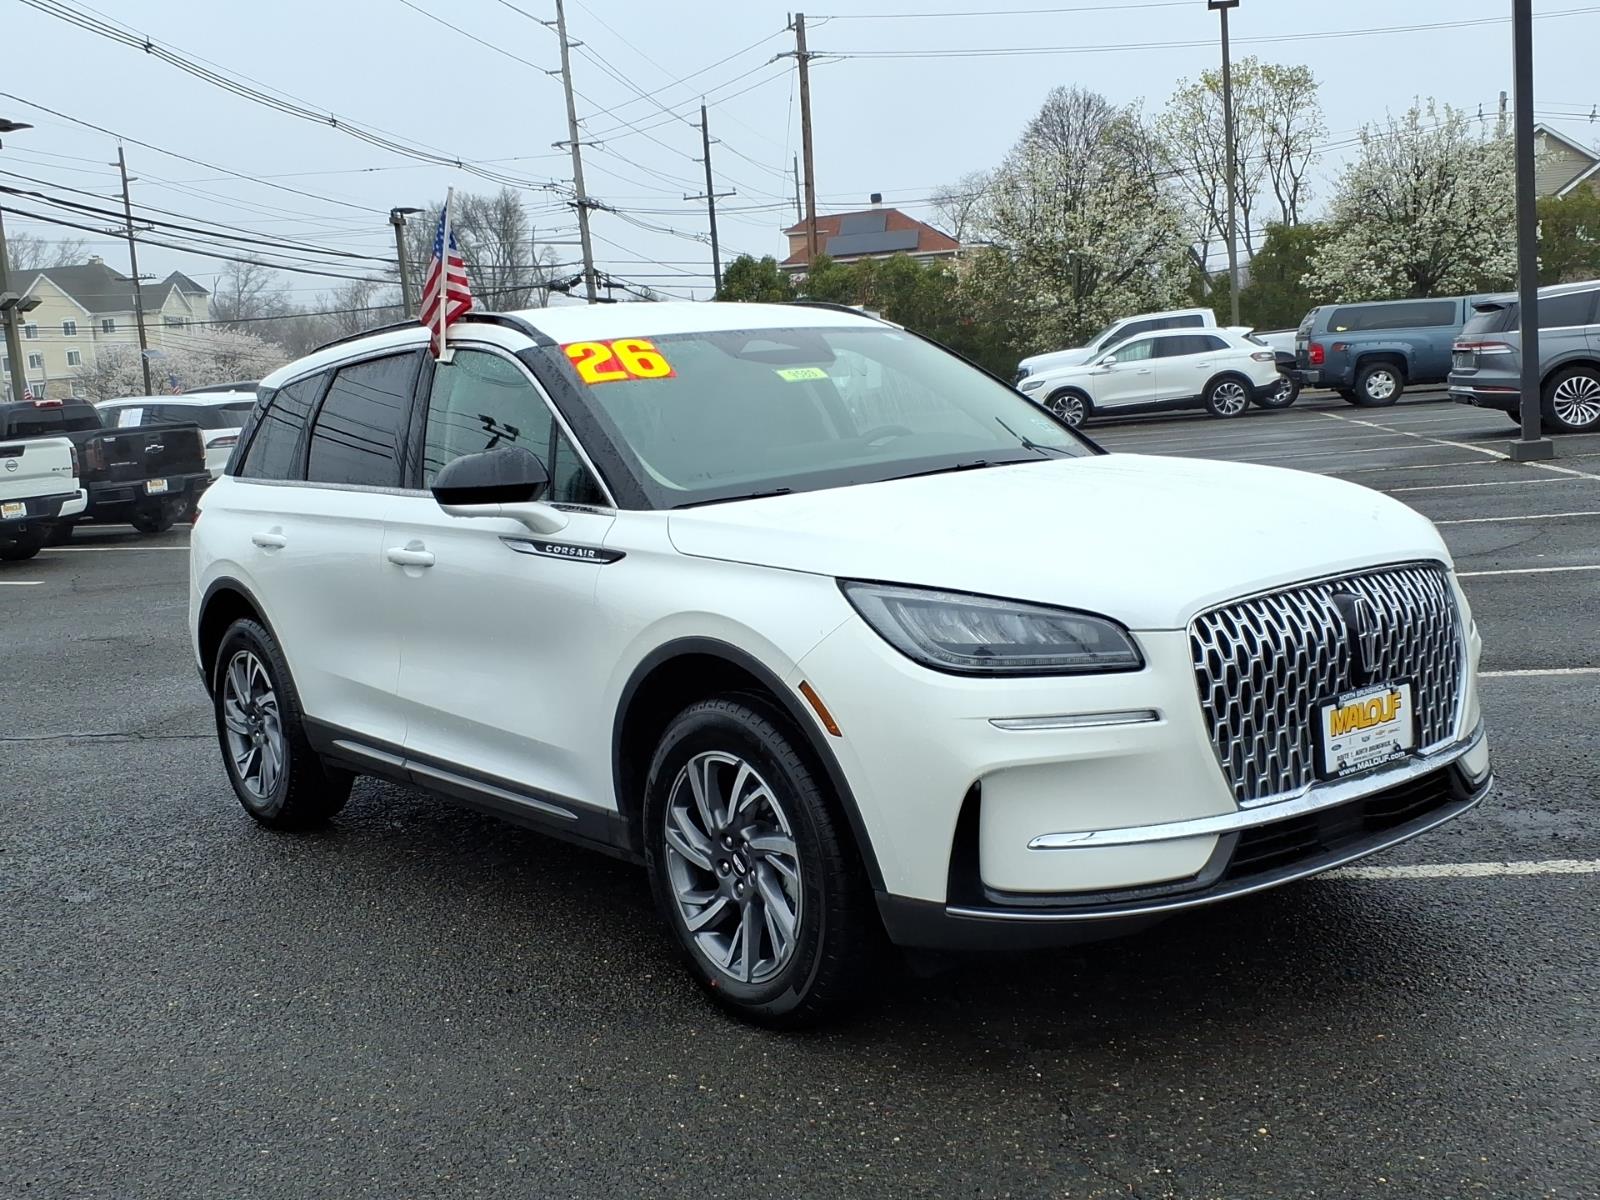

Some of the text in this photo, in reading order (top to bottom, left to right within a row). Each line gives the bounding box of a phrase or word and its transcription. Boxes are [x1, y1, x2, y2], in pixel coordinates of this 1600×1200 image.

[565, 338, 671, 384] 26
[545, 544, 595, 558] CORSAIR
[1330, 692, 1402, 737] MALOUF
